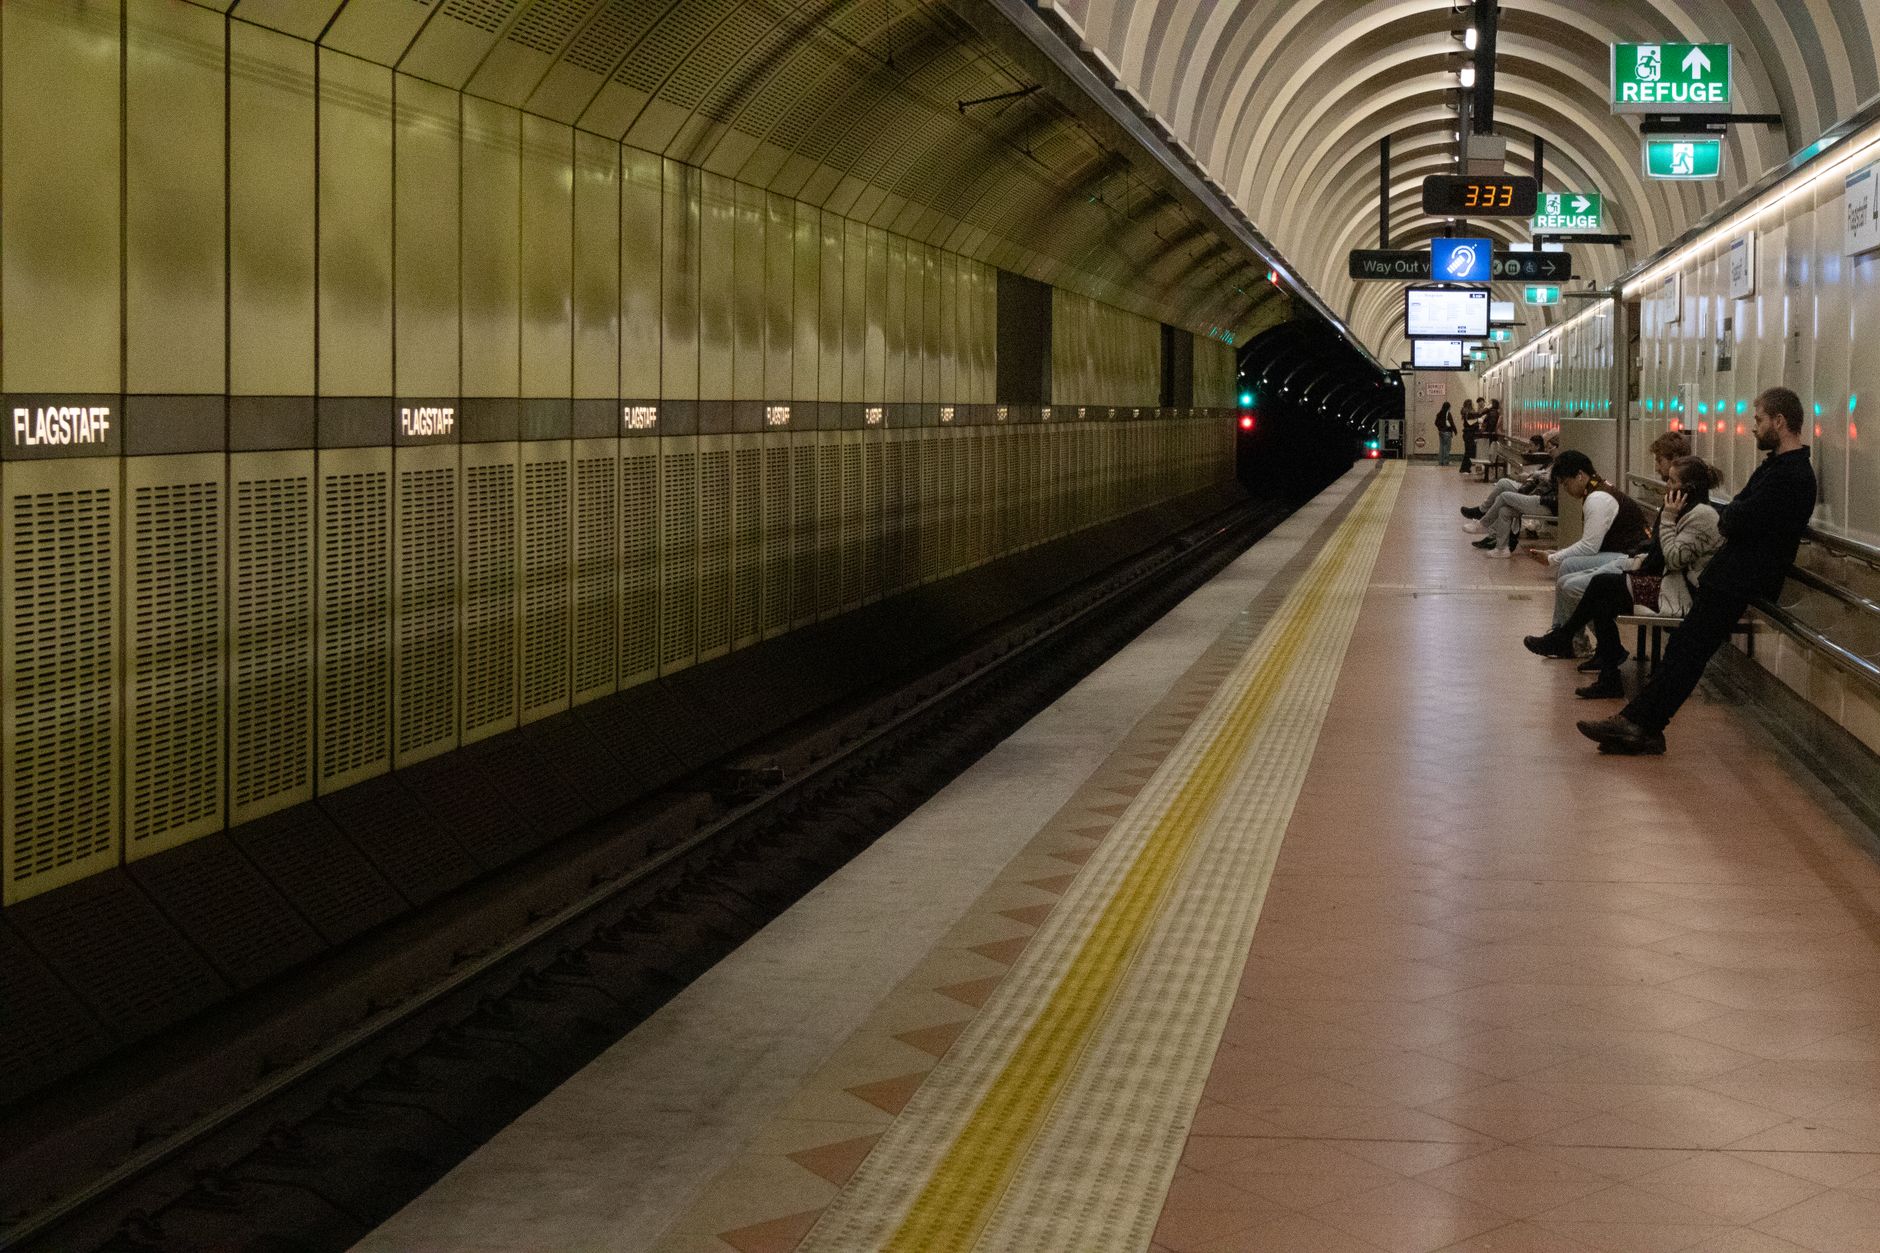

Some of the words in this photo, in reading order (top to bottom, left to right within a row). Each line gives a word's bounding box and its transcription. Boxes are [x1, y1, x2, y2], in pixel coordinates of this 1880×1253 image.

[1622, 82, 1723, 102] REFUGE
[1464, 185, 1513, 207] 333
[1537, 215, 1597, 227] REFUGE
[1363, 260, 1392, 275] Way
[1395, 260, 1419, 273] Out
[13, 406, 110, 446] FLAGSTAFF
[401, 407, 454, 436] FLAGSTAFF
[624, 406, 657, 430] FLAGSTAFF
